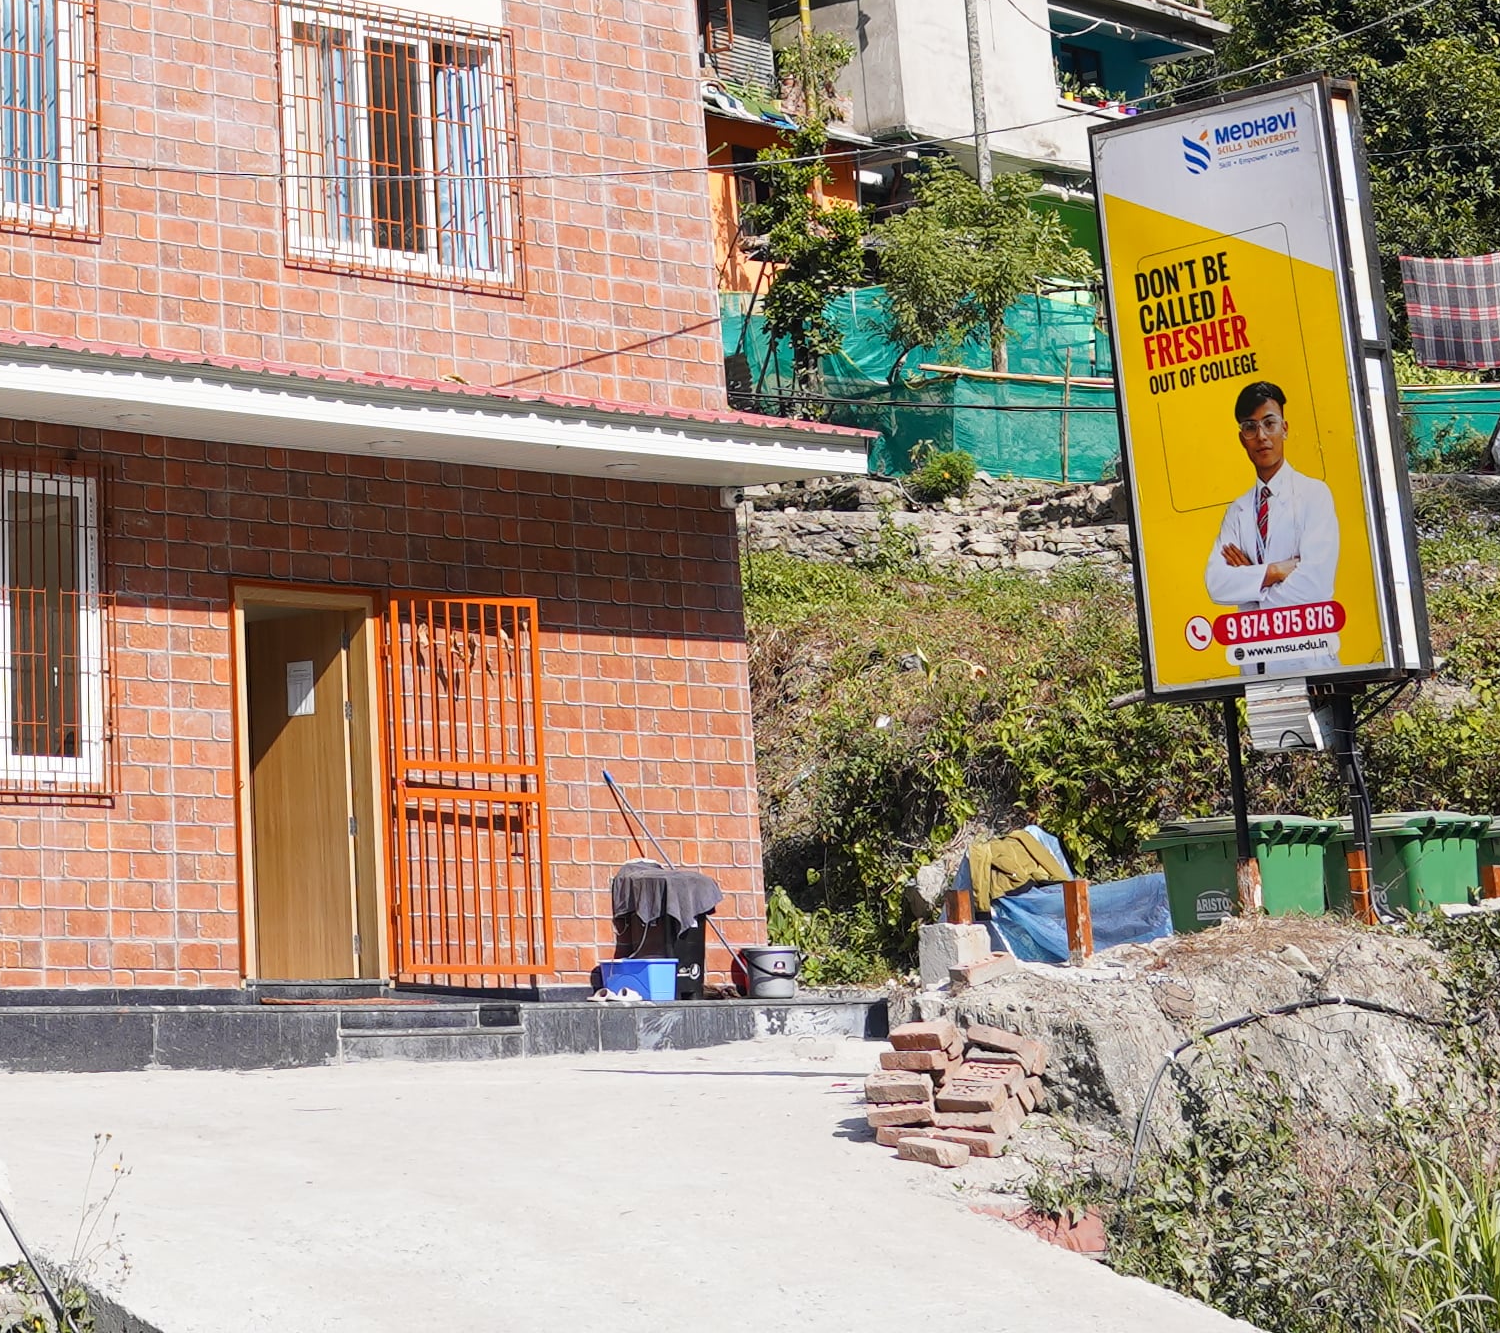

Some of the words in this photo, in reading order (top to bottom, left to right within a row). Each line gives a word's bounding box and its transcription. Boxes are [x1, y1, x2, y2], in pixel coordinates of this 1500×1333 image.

[1217, 142, 1242, 155] SKILLS
[1247, 130, 1297, 148] UNIVERSITY
[1239, 154, 1268, 165] Empower
[1134, 259, 1196, 302] DON'T
[1202, 251, 1230, 285] BE
[1139, 290, 1216, 334] CALLED
[1222, 285, 1237, 316] A
[1143, 315, 1251, 370] FRESHER
[1149, 371, 1176, 395] OUT
[1180, 366, 1196, 388] OF
[1200, 352, 1259, 383] COLLEGE
[1226, 617, 1238, 640] 9
[1240, 613, 1270, 638] 874
[1273, 609, 1302, 635] 875
[1305, 605, 1335, 631] 876
[1247, 638, 1328, 657] www.msu.edu.in
[1197, 897, 1229, 912] ARISTO
